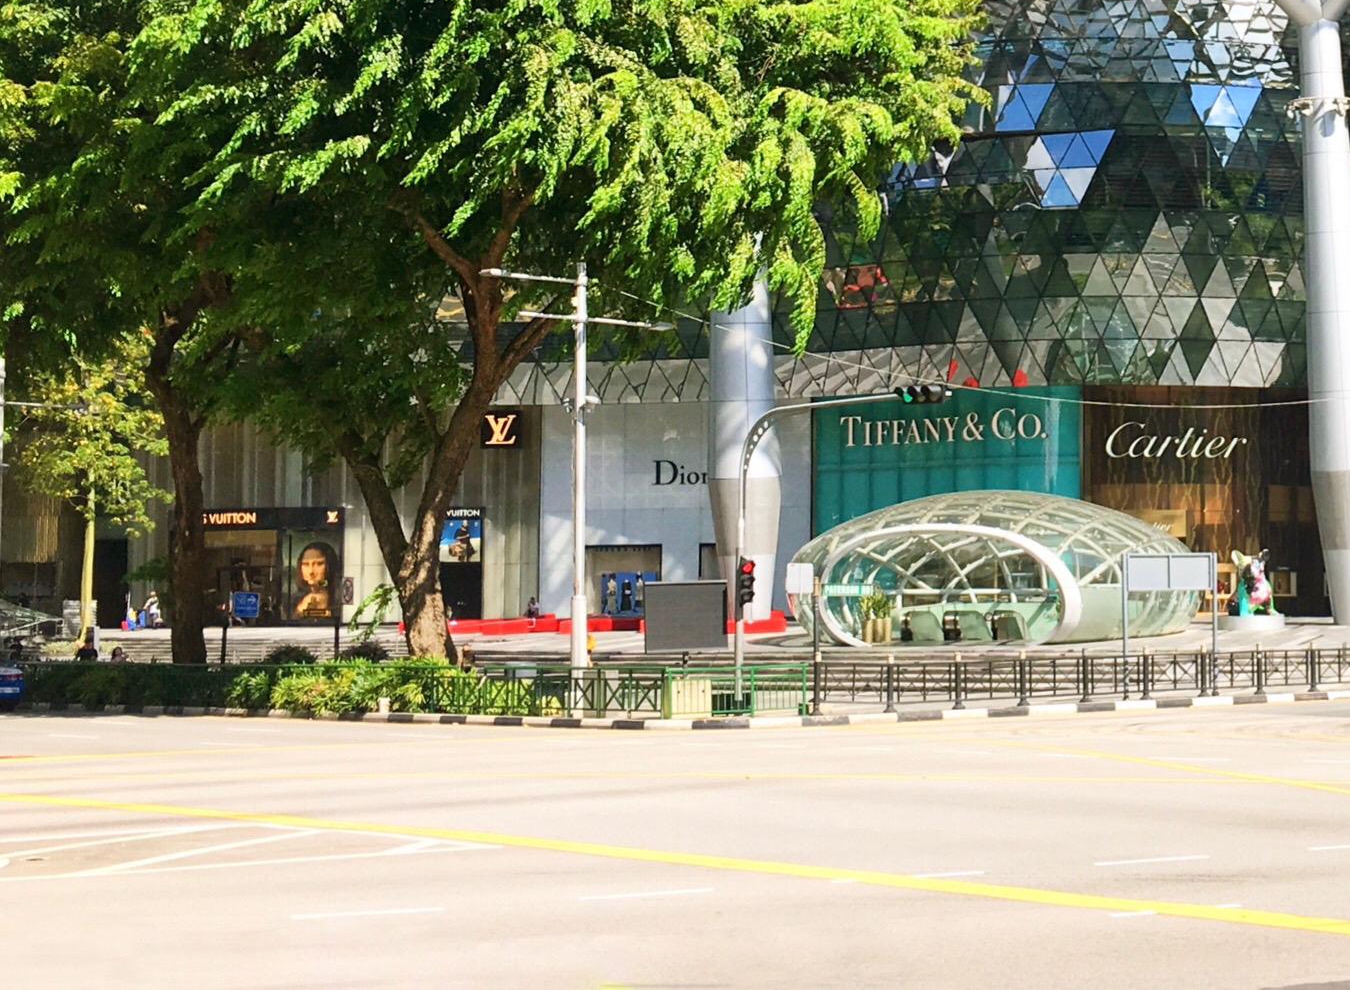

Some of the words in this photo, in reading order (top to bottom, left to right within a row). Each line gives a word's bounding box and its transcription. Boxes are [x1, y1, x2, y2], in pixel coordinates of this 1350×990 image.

[840, 415, 959, 447] TIFFANY
[1105, 421, 1247, 459] Cartier
[652, 460, 707, 485] Dior
[209, 512, 257, 525] VUITTON
